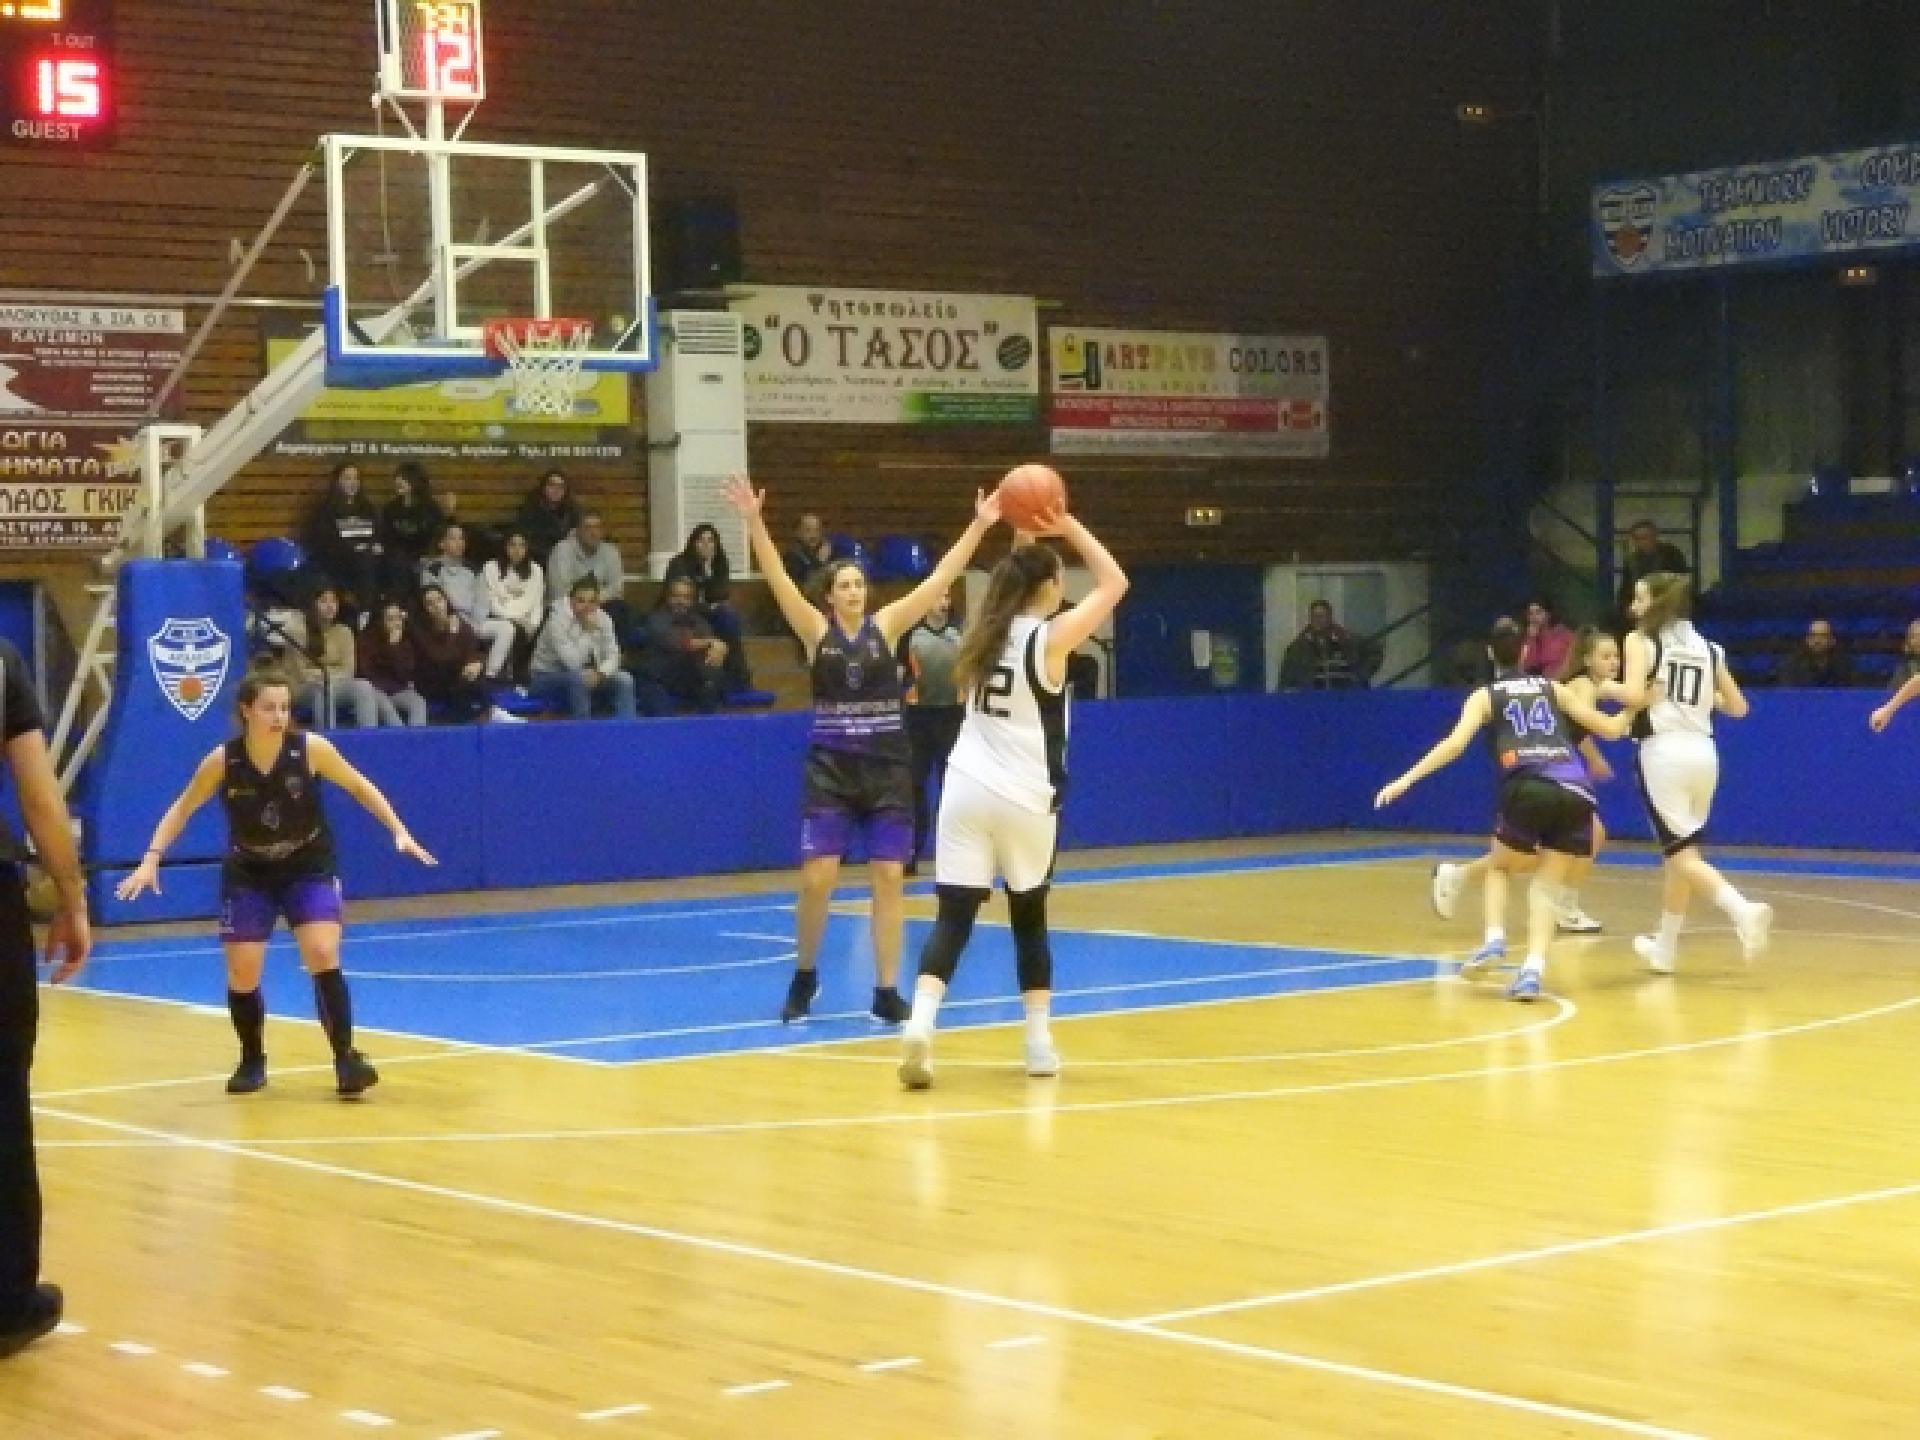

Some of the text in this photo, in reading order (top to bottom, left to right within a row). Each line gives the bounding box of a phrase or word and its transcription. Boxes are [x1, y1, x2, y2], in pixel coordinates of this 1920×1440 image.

[423, 32, 472, 93] 12
[37, 59, 100, 117] 15
[11, 119, 82, 141] GUEST
[1666, 660, 1704, 707] 10
[1503, 696, 1557, 738] 14
